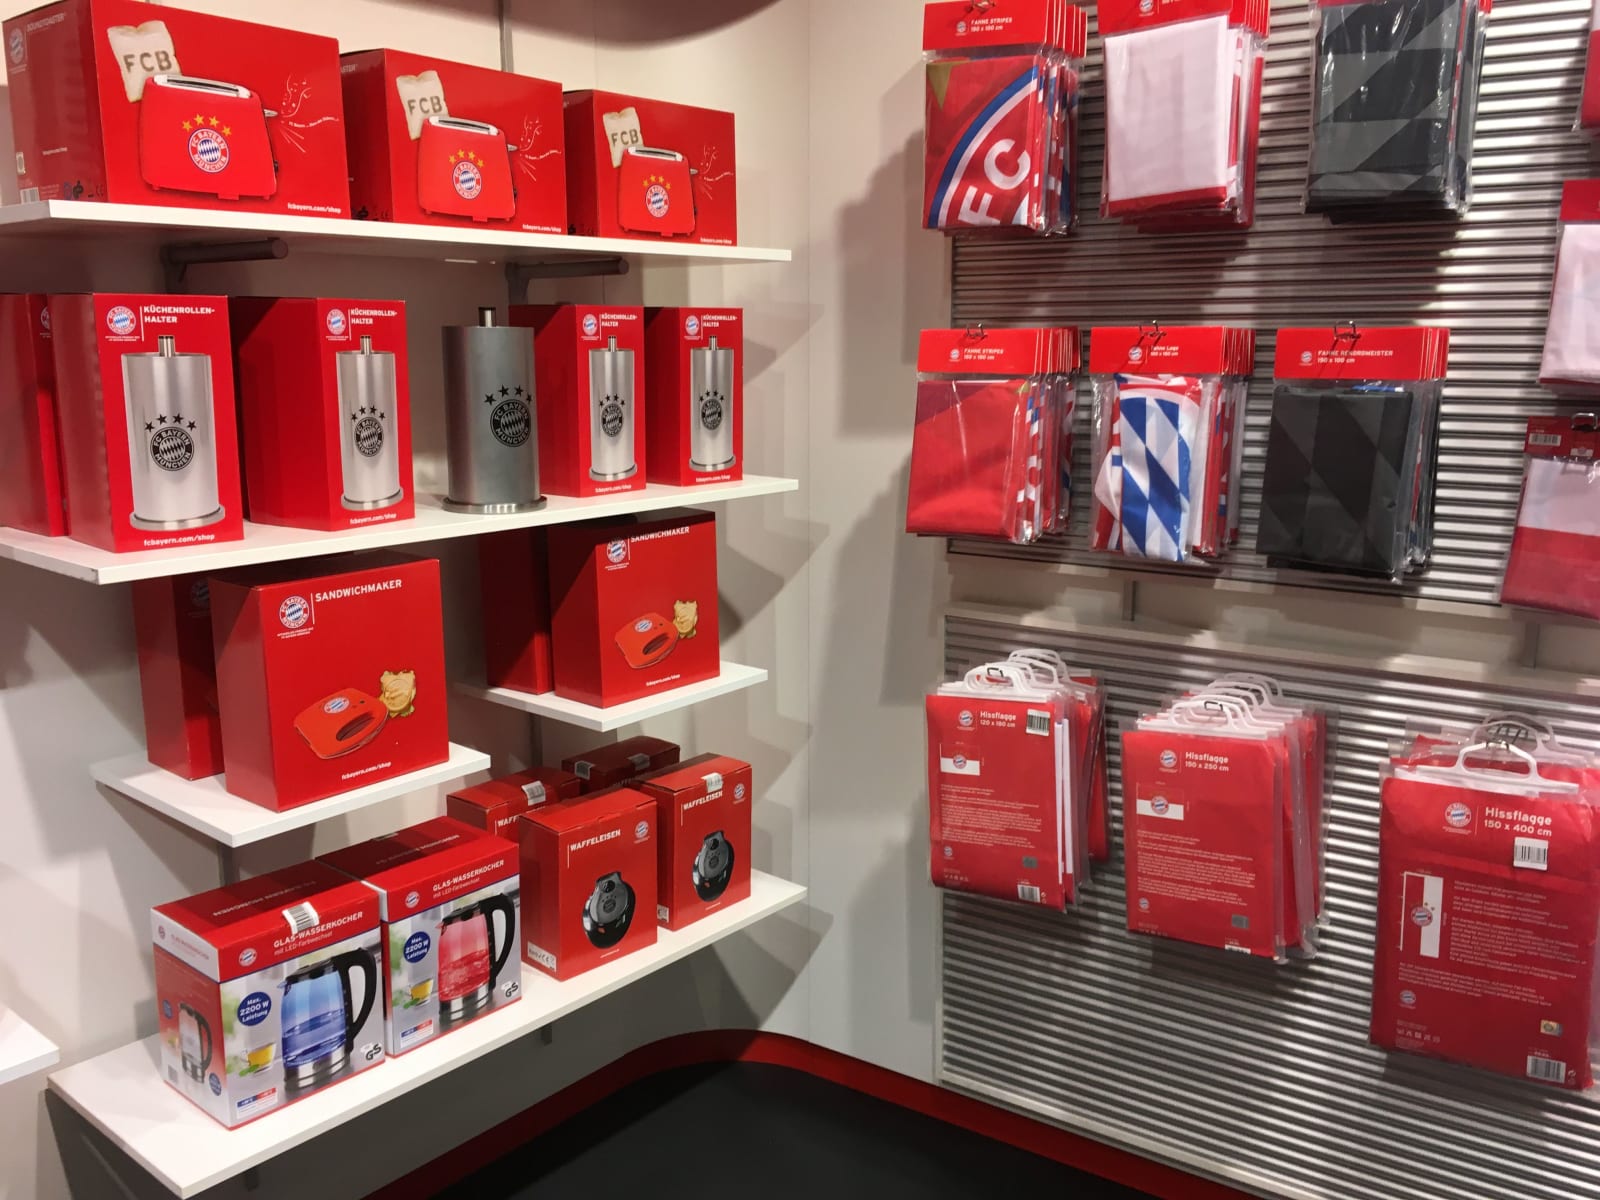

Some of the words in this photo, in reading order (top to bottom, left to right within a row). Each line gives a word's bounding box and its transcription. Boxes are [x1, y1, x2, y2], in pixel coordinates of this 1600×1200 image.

[123, 50, 172, 73] FCB
[407, 96, 443, 114] FCB
[611, 129, 639, 146] FCB
[143, 305, 216, 315] KÜCHENROLLEN-
[350, 308, 398, 317] KÜCHENROLLEN-
[144, 316, 178, 324] HALTER
[144, 533, 216, 547] fcbayern.com/shop
[630, 526, 690, 543] SANDWICHMAKER
[315, 578, 403, 602] SANDWICHMAKER
[980, 711, 1016, 722] Hissflagge
[1185, 752, 1229, 765] Hissflagge
[1204, 762, 1217, 770] 250
[683, 790, 723, 811] WAFFELEISEN
[1485, 806, 1552, 826] Hissflagge
[1484, 820, 1501, 829] 150
[1513, 824, 1534, 834] 400
[1537, 829, 1552, 837] cm
[570, 829, 621, 852] WAFFELEISEN
[432, 860, 505, 892] GLAS-WASSERKOCHER
[273, 911, 363, 949] GLAS-WASSERKOCHER
[405, 943, 423, 954] 2200
[423, 939, 429, 947] W
[505, 981, 518, 998] GS
[240, 1004, 261, 1016] 2200
[262, 1000, 270, 1008] W
[247, 997, 262, 1005] Max.
[242, 1009, 268, 1023] Leistung
[365, 1043, 382, 1060] GS
